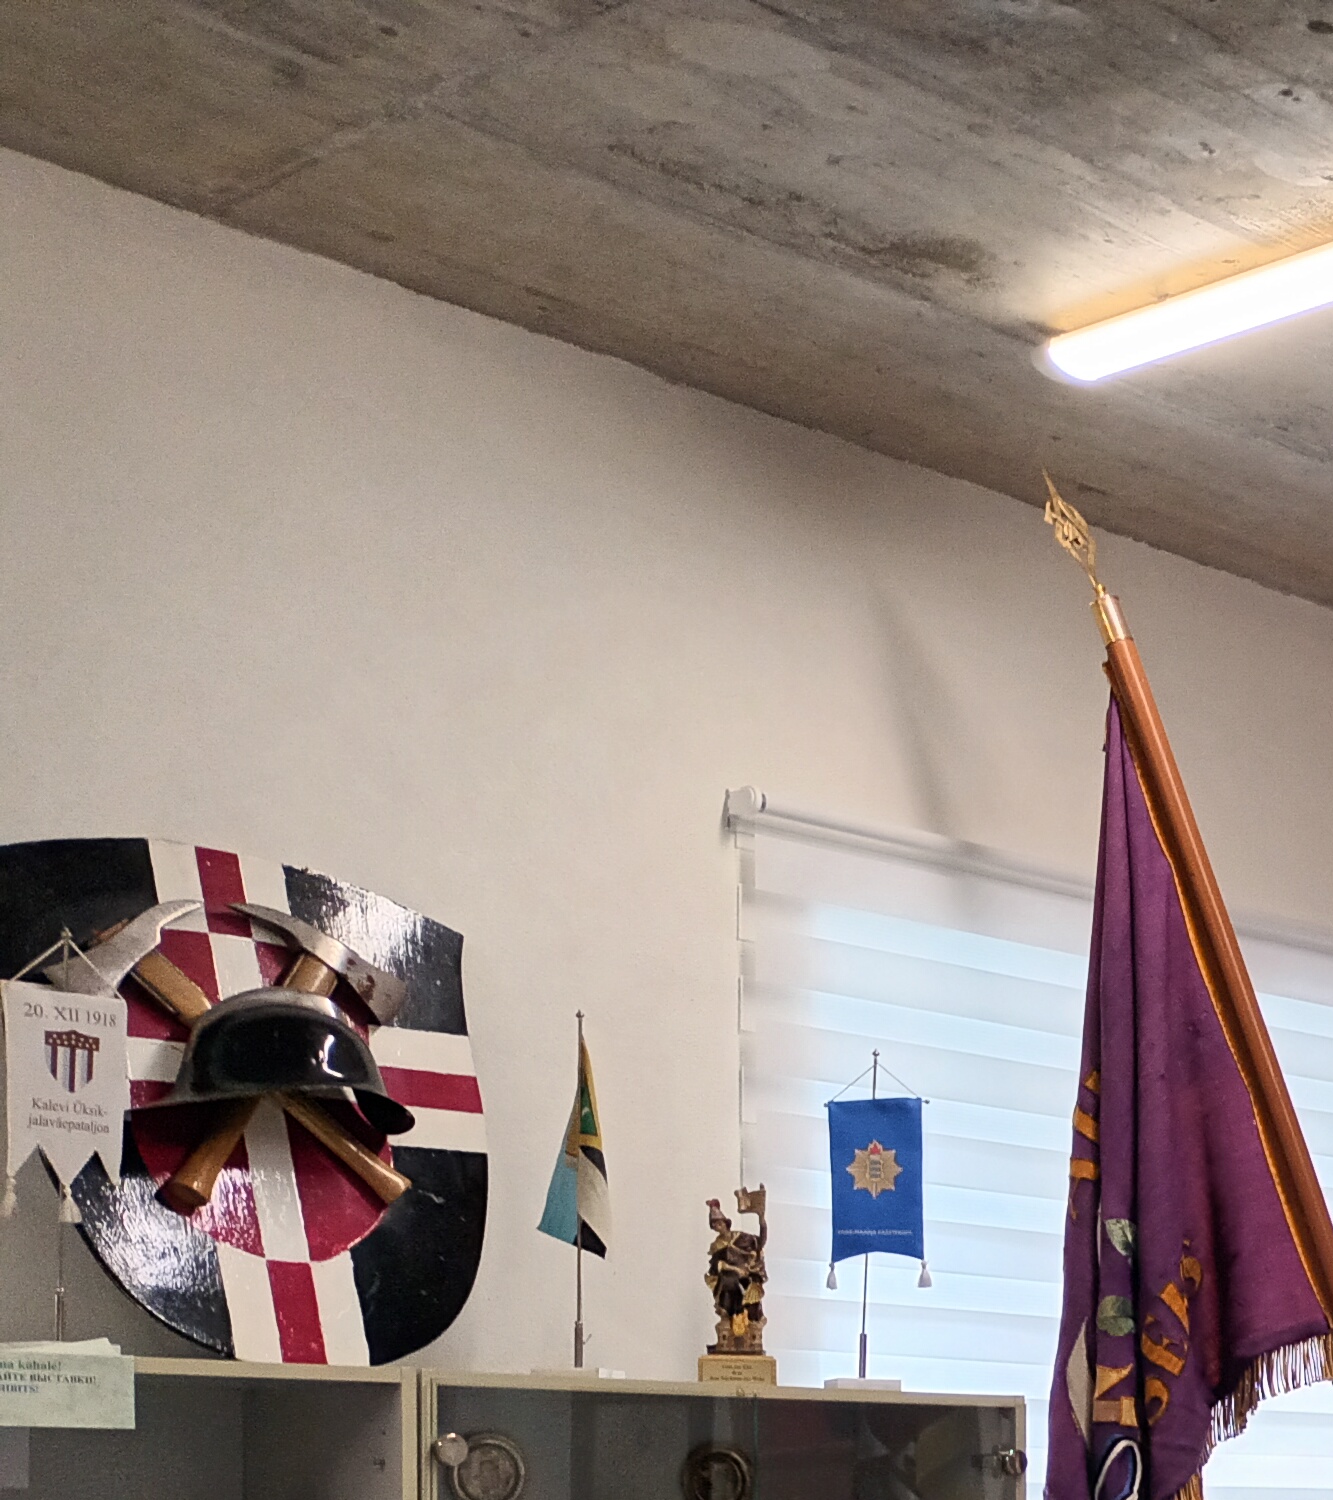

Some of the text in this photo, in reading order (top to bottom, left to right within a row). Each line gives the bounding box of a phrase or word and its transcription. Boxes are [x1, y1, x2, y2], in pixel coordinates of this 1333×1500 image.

[23, 1001, 117, 1027] 20. XII 1918
[31, 1097, 108, 1118] Kalevi Üksik-
[27, 1114, 110, 1135] jalaväepataljon
